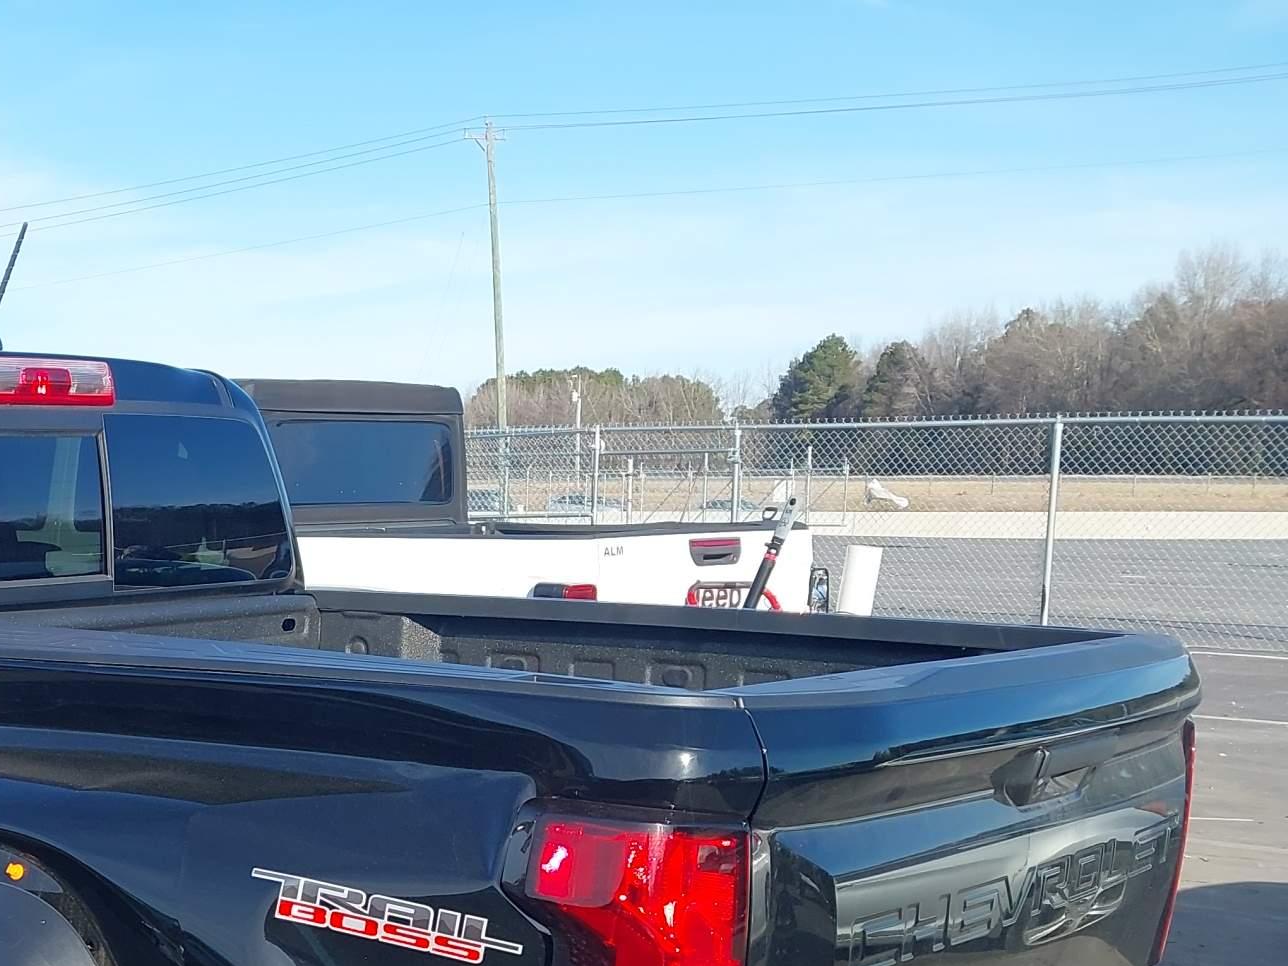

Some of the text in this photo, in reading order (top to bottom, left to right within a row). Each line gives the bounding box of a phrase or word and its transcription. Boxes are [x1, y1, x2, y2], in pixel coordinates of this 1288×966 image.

[603, 545, 624, 557] ALM
[251, 867, 523, 955] TRAIL
[274, 898, 485, 965] BOSS
